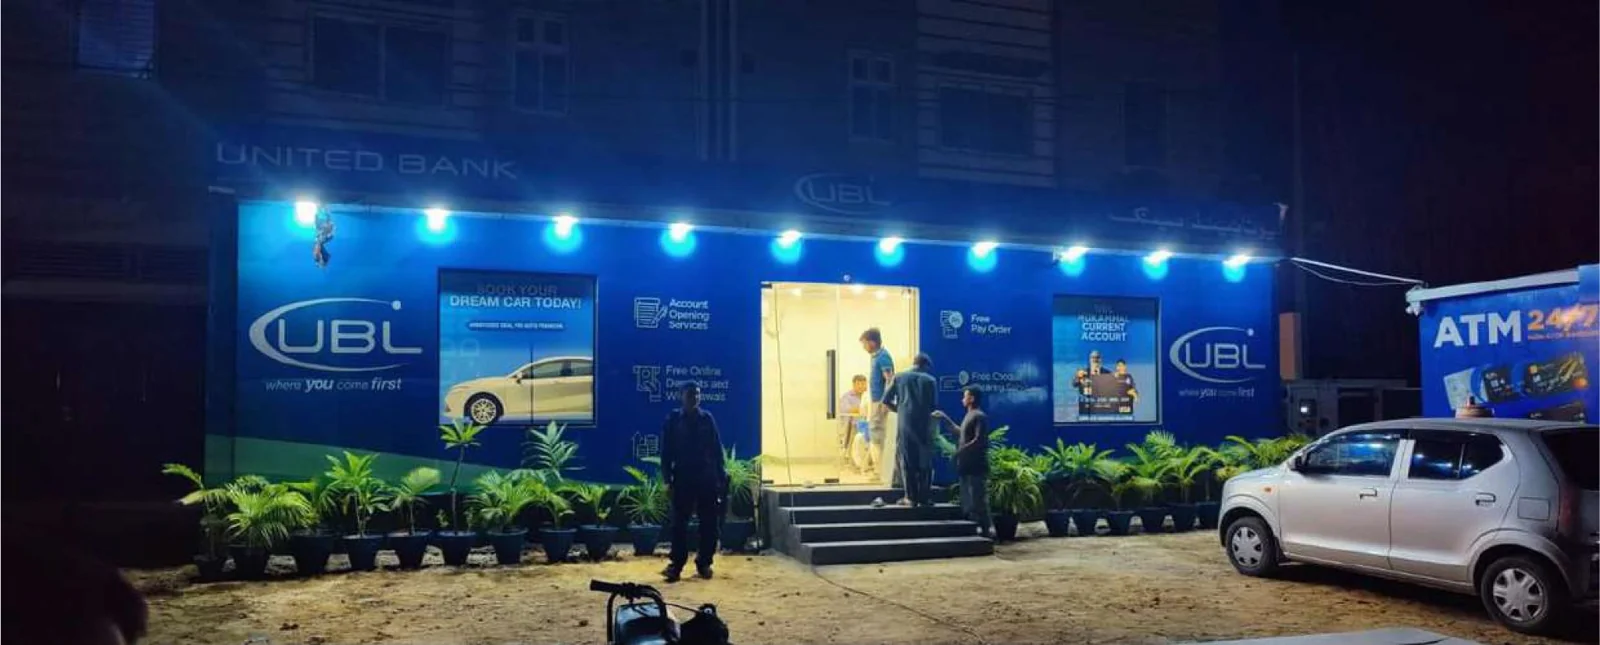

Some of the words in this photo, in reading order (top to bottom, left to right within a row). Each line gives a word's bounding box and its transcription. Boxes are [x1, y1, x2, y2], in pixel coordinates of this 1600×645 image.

[216, 143, 384, 171] UNITED
[398, 153, 518, 180] BANK
[808, 181, 890, 206] UBL
[476, 283, 518, 295] BOOK
[519, 284, 558, 297] YOUR
[450, 295, 499, 308] DREAM
[503, 297, 531, 308] CAR
[533, 297, 582, 309] TODAY!
[669, 299, 709, 309] Account
[669, 309, 710, 321] Opening
[971, 314, 990, 323] Free
[668, 320, 708, 330] Services
[971, 323, 986, 335] Pay
[988, 324, 1012, 334] Order
[1083, 322, 1126, 332] CURRENT
[1434, 310, 1522, 348] ATM
[278, 318, 423, 354] UBL
[1082, 332, 1128, 342] ACCOUNT
[1185, 342, 1266, 369] UBL
[665, 365, 688, 376] Free
[690, 365, 722, 377] Online
[265, 379, 302, 391] where
[304, 378, 334, 394] you
[336, 380, 369, 391] come
[371, 376, 402, 391] first
[711, 379, 729, 389] and
